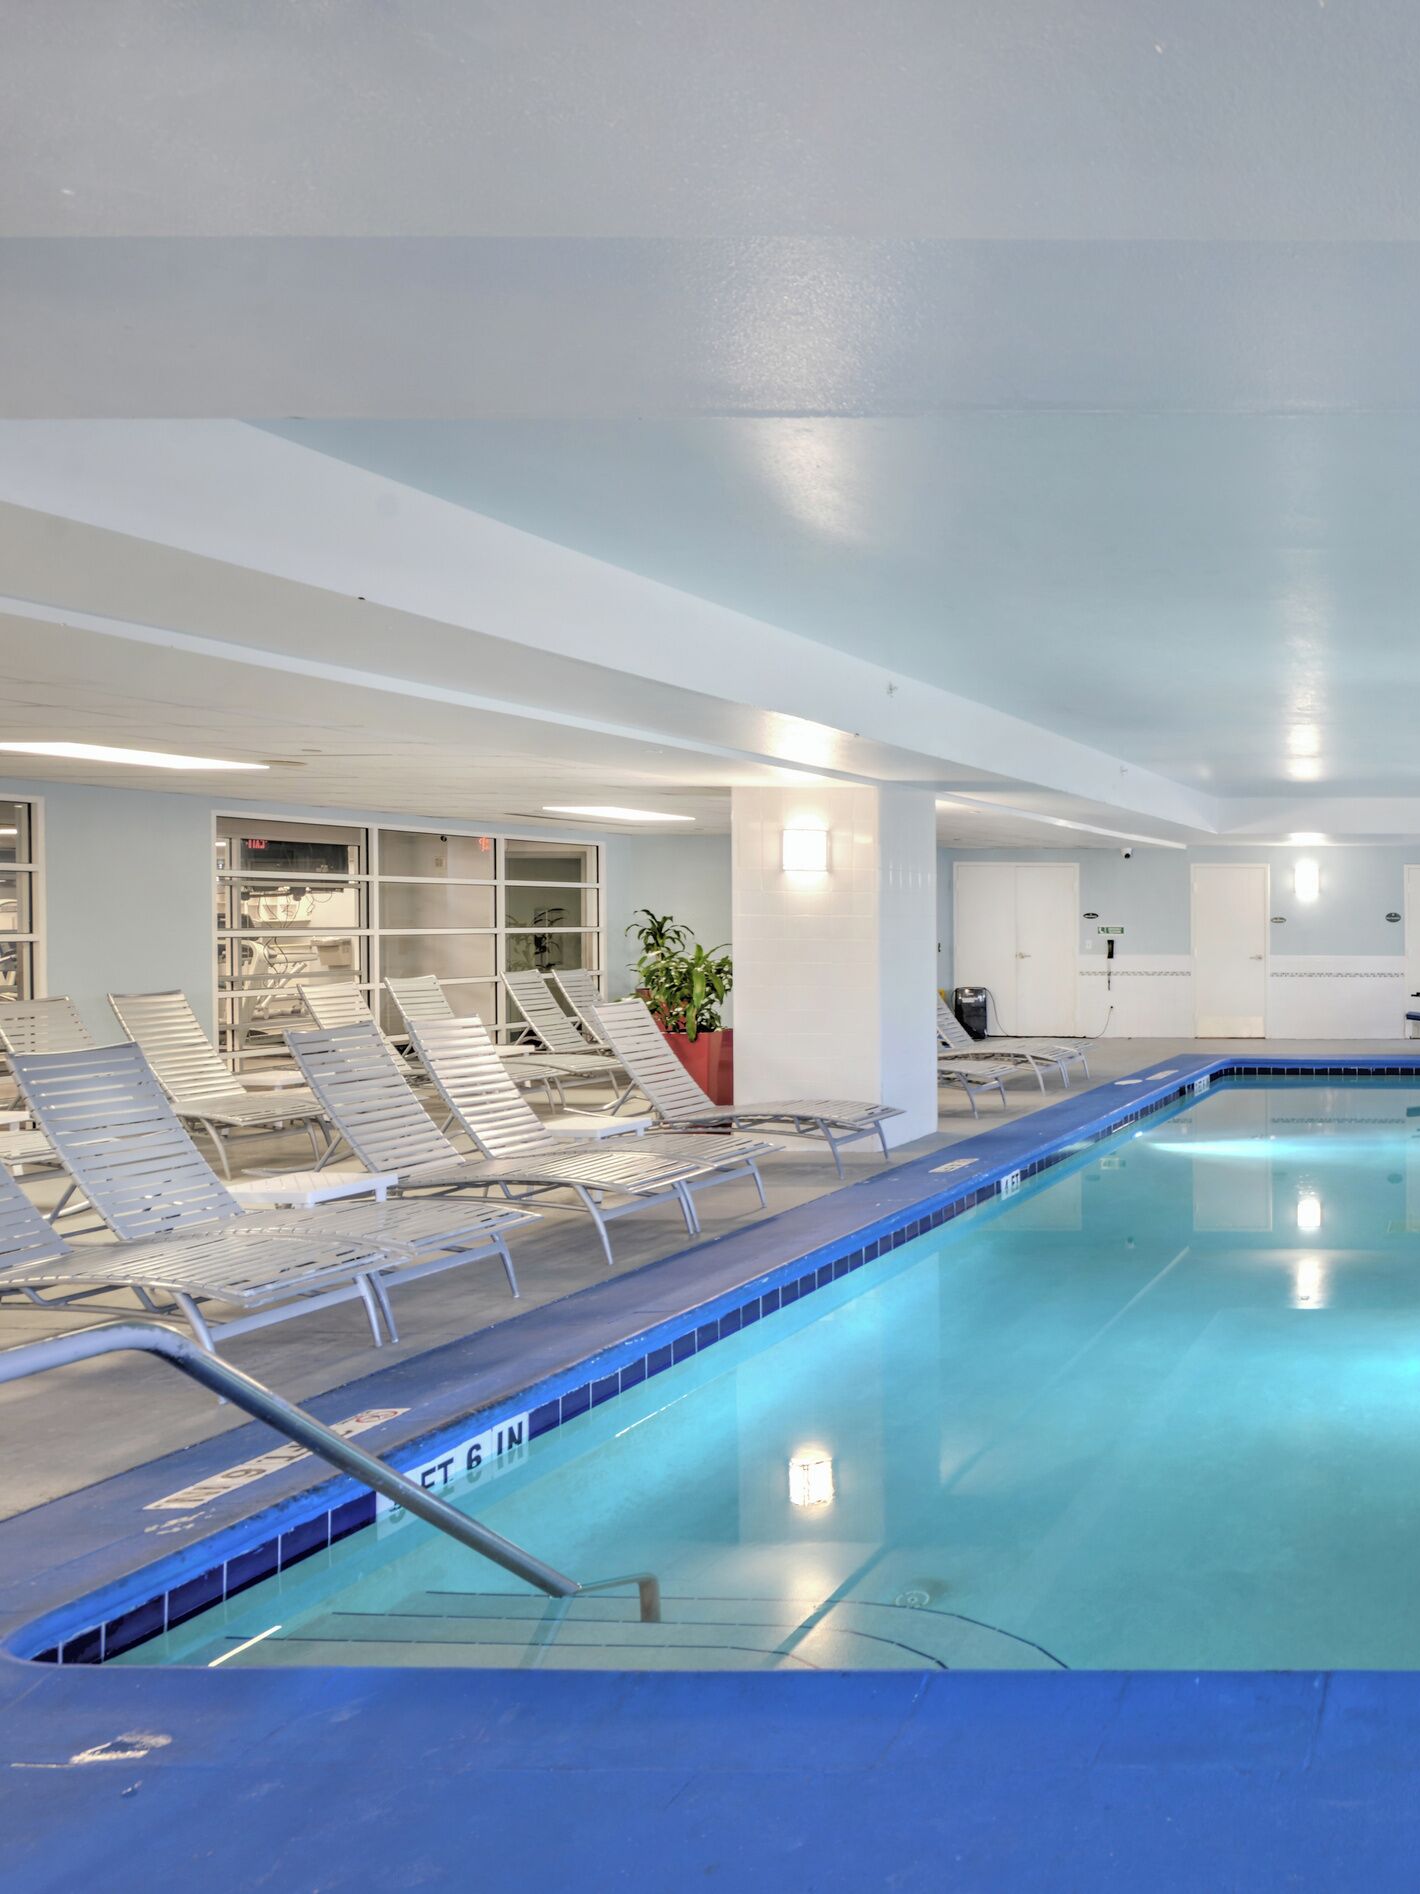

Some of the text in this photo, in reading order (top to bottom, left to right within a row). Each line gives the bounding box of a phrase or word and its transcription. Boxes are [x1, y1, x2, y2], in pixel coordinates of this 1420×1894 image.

[220, 1467, 267, 1480] 6
[421, 1421, 523, 1489] FT 6 IN
